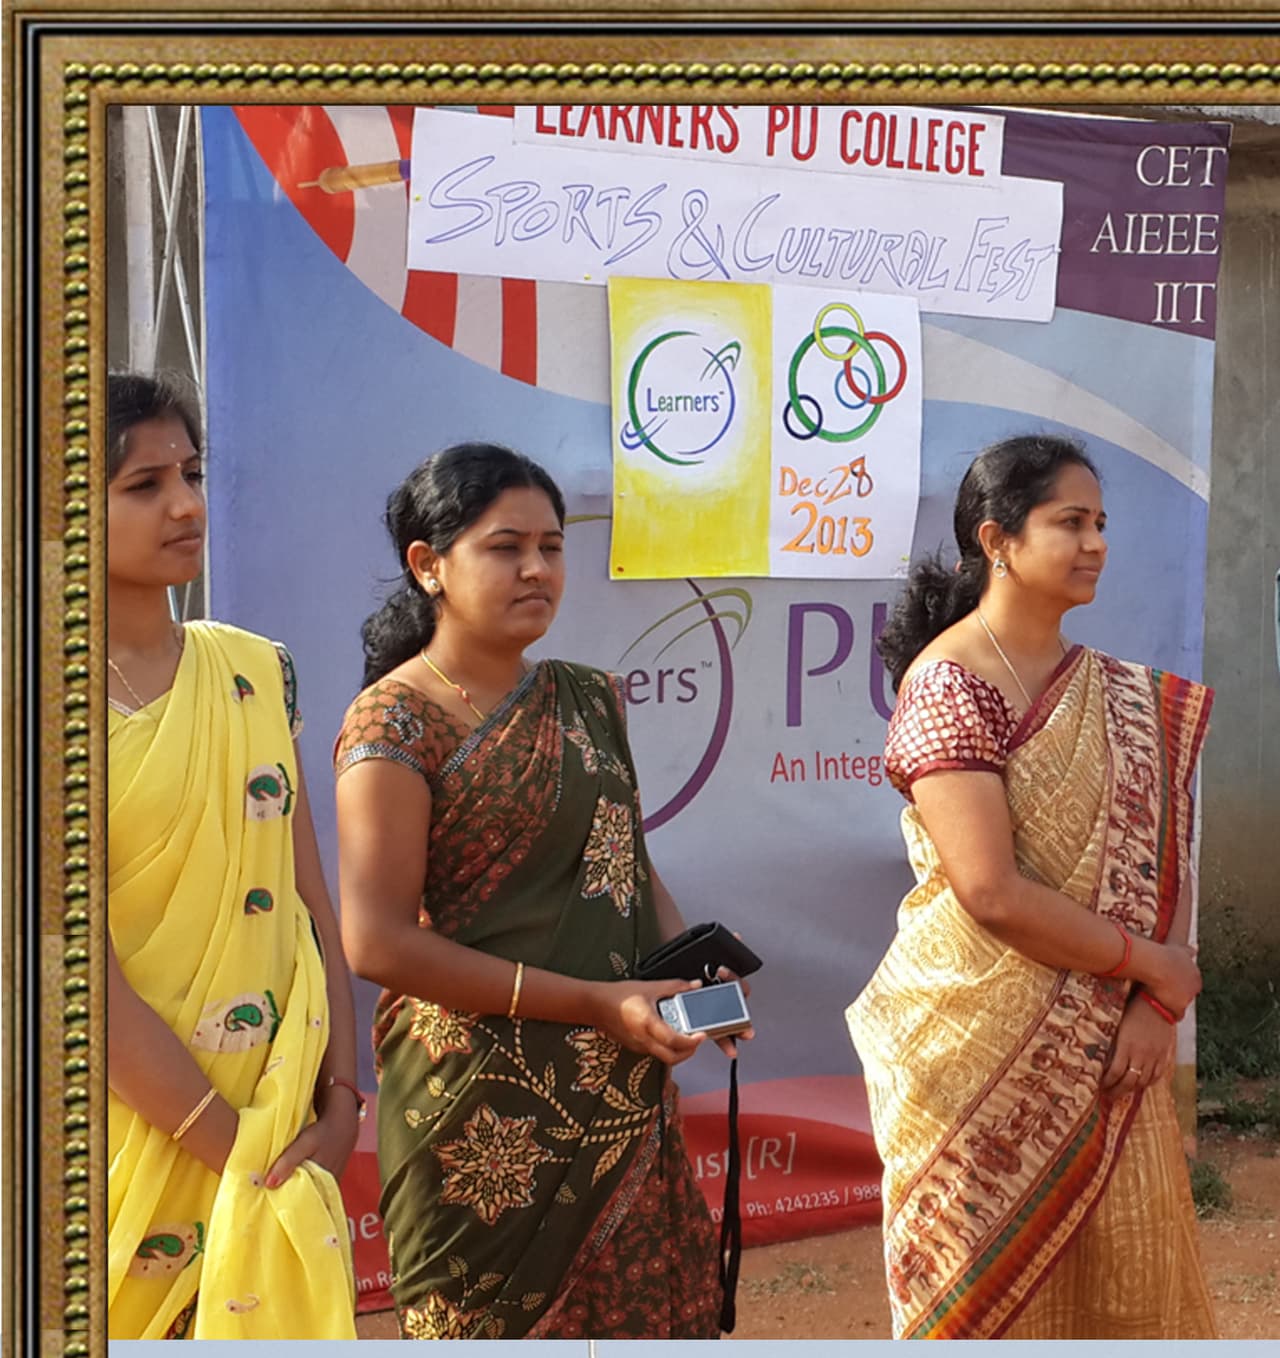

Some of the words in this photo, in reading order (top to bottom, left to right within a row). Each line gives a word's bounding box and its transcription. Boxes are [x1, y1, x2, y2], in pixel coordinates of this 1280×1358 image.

[535, 105, 740, 154] LEARNERS
[766, 105, 819, 161] PU
[839, 109, 986, 176] COLLEGE
[1136, 145, 1227, 186] CET
[425, 155, 668, 266] SPORTS
[667, 189, 731, 280] &
[733, 193, 950, 290] CULTURAL
[954, 216, 1057, 303] FEST
[1089, 212, 1221, 255] AIEEE
[1152, 282, 1216, 323] IIT
[646, 388, 719, 413] Learners
[780, 501, 874, 558] 2013
[770, 752, 806, 783] An
[815, 751, 890, 787] Integ
[746, 1131, 796, 1180] [R]
[746, 1199, 771, 1218] Ph:
[775, 1190, 840, 1214] 4242235
[852, 1183, 882, 1202] 988
